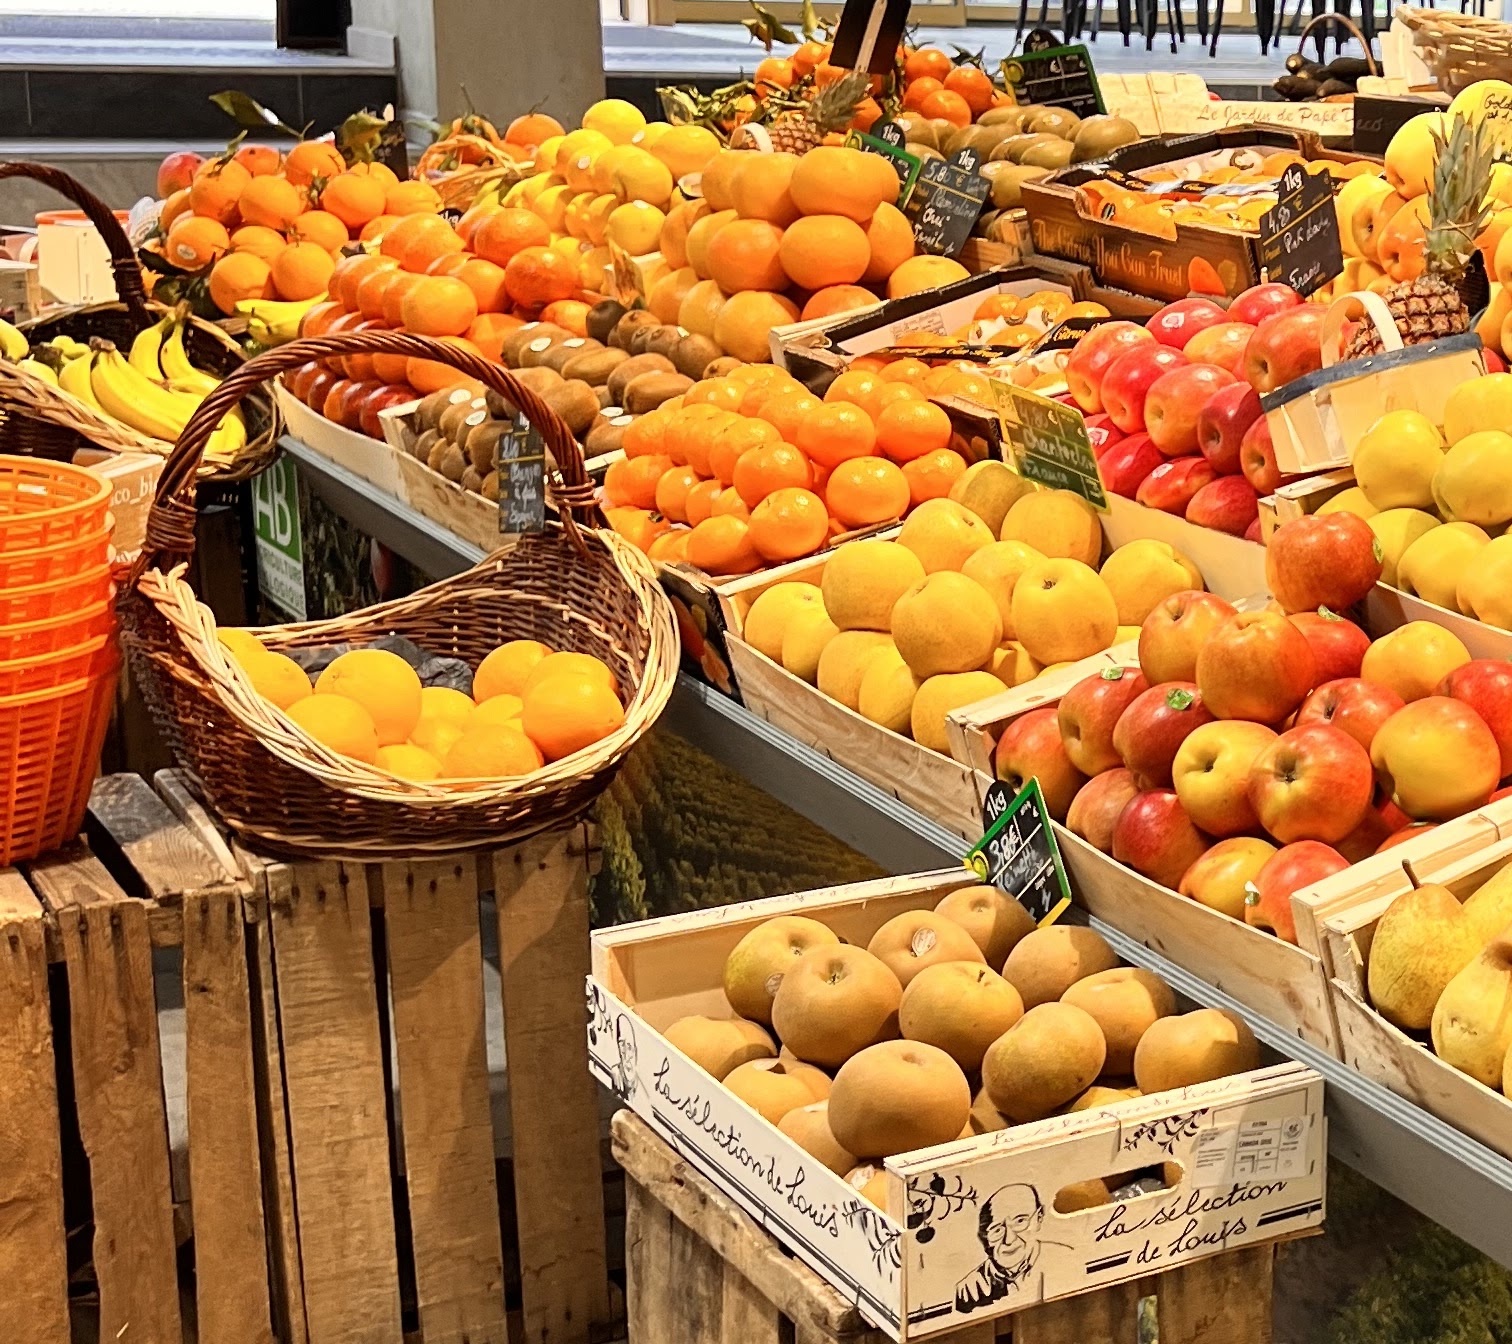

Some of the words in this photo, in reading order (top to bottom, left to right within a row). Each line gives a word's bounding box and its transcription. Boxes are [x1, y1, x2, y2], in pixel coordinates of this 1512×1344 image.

[882, 125, 901, 146] 1kg
[957, 149, 977, 171] 1kg
[1283, 167, 1304, 193] 1kg
[986, 789, 1007, 821] 1kg
[653, 1055, 682, 1105] La
[677, 1092, 764, 1178] sélection
[766, 1156, 783, 1196] de
[785, 1166, 840, 1238] Louis
[1094, 1203, 1142, 1243] La
[1140, 1180, 1288, 1231] sélection
[1136, 1239, 1163, 1264] de
[1167, 1217, 1248, 1258] Louis
